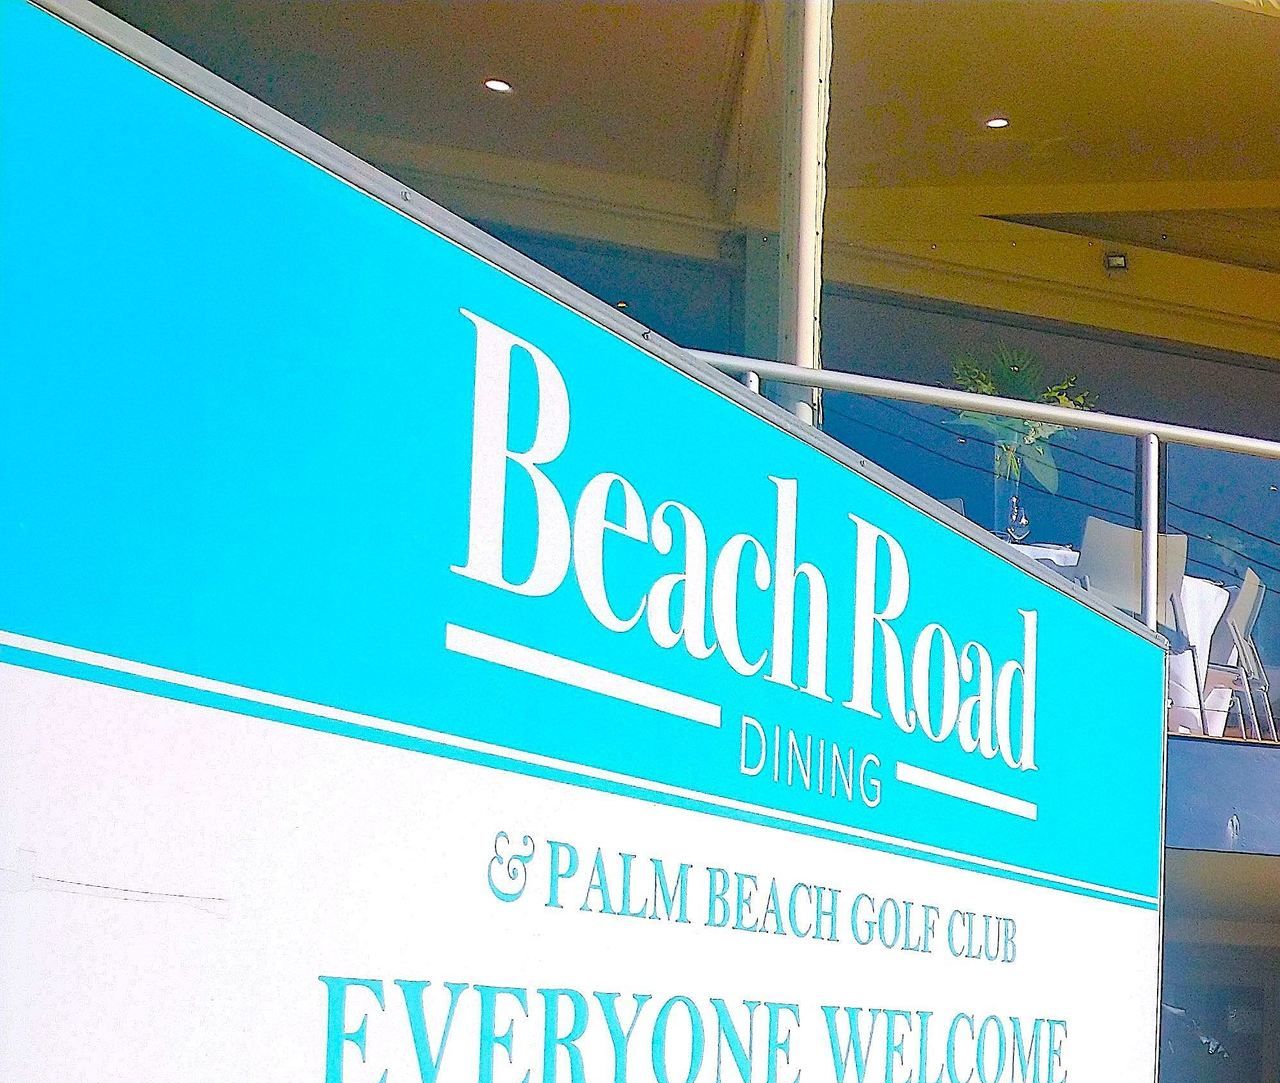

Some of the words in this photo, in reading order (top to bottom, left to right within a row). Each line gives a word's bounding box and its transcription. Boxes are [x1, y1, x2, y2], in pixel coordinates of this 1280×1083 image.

[450, 308, 831, 702] Beach
[843, 514, 1038, 771] Road
[741, 715, 882, 808] DINING
[487, 830, 535, 902] &
[544, 839, 693, 924] PALM
[704, 866, 841, 943] BEACH
[850, 892, 940, 953] GOLF
[947, 909, 1017, 964] CLUB
